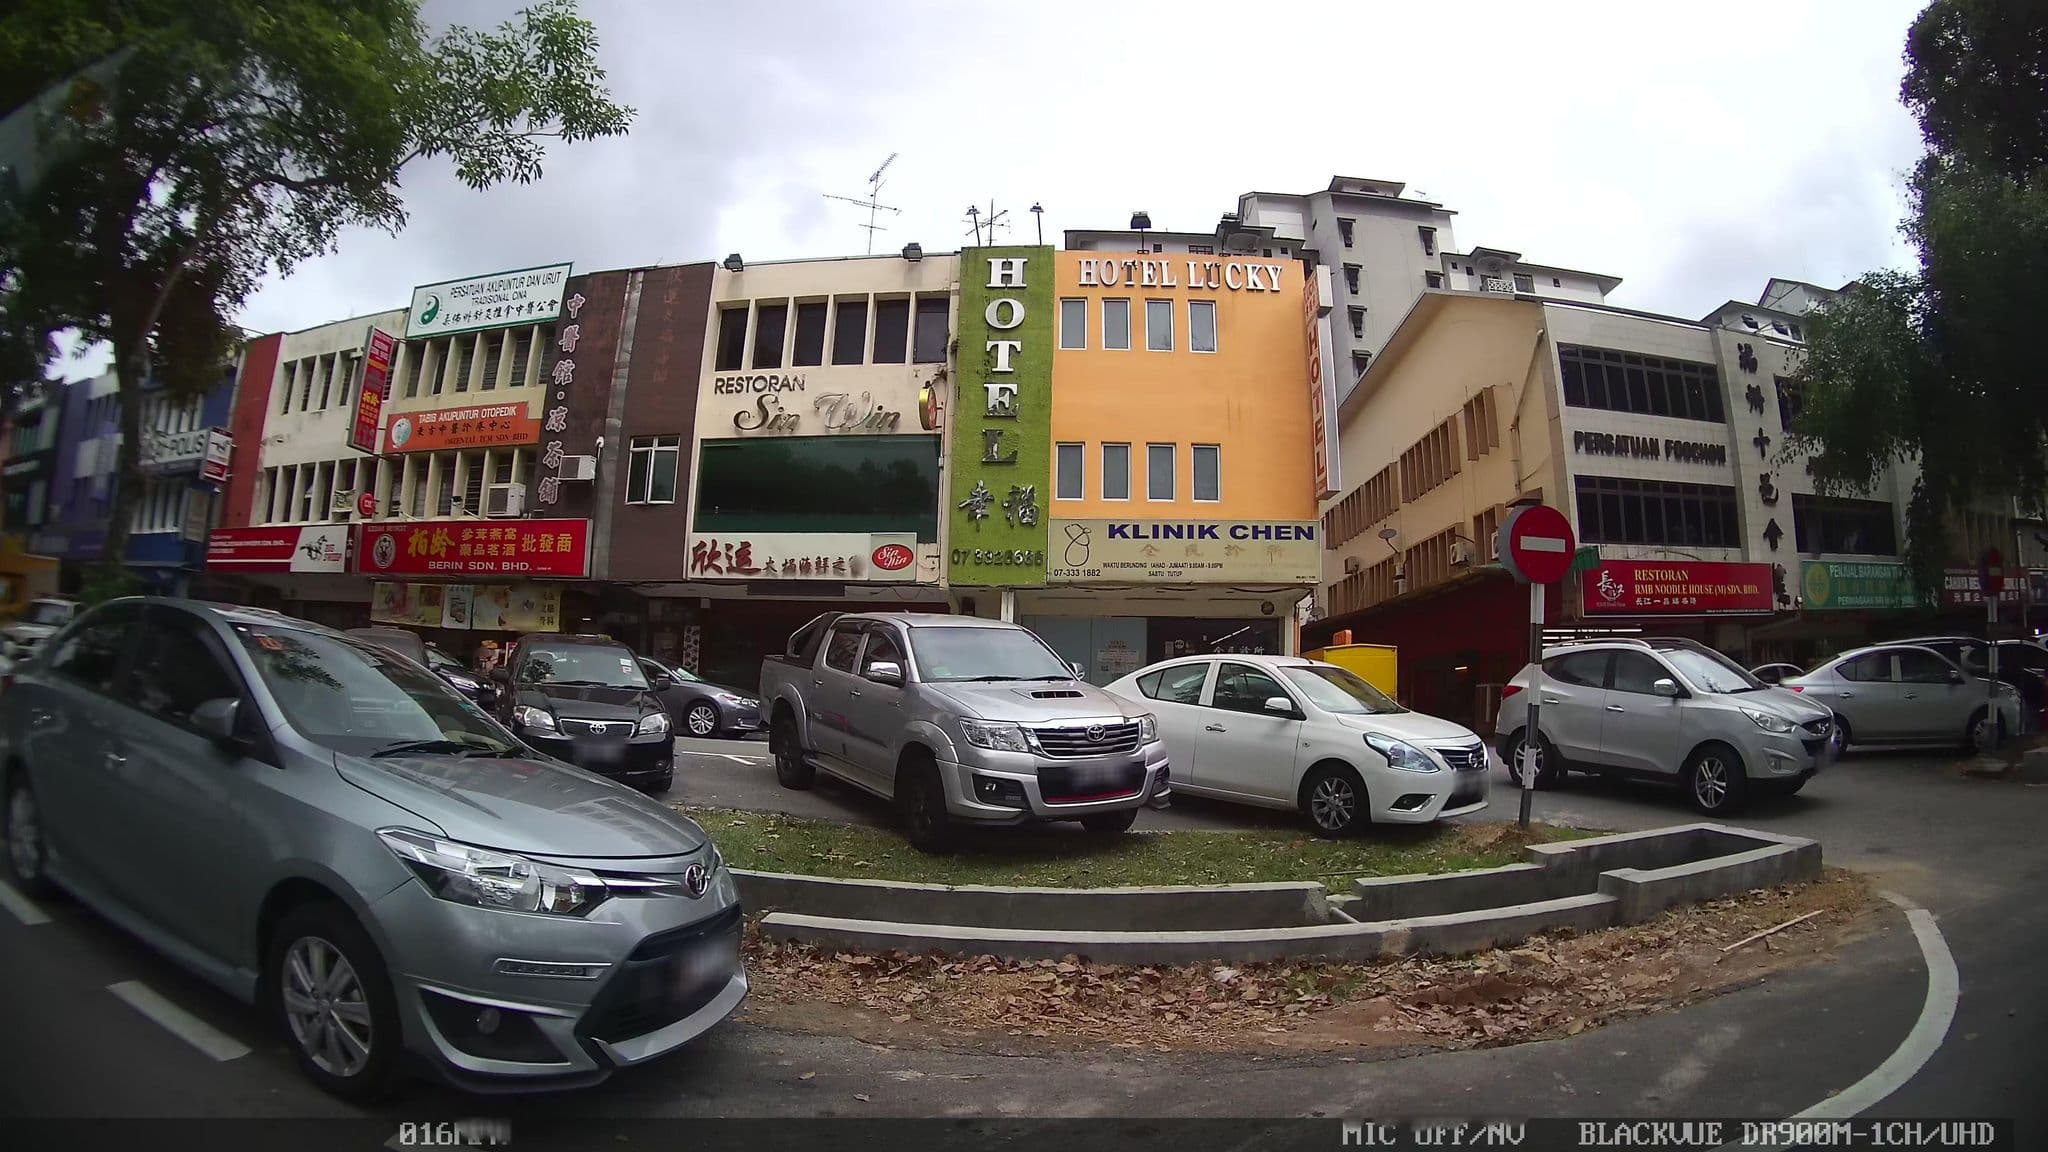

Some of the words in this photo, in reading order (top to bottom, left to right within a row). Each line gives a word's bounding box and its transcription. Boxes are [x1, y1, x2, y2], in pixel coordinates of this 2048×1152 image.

[487, 276, 525, 292] AKUPUNTUR
[526, 274, 541, 287] DAN
[542, 271, 562, 284] URUT
[1079, 259, 1177, 287] HOTEL
[1186, 260, 1283, 292] LUCKY
[512, 291, 527, 301] CINA
[981, 258, 1028, 464] HOTEL
[714, 374, 805, 395] RESTORAN
[1308, 325, 1327, 478] HOTEL
[438, 408, 479, 422] AKUPUNTUR
[481, 405, 517, 418] OTOPEDIK
[733, 393, 801, 432] Sin
[813, 390, 901, 431] Win
[512, 432, 529, 440] BHD
[1574, 430, 1661, 462] PERSATUAN
[1664, 439, 1727, 467] FOOCHOW
[1108, 523, 1221, 540] KLINIK
[1229, 524, 1315, 541] CHEN
[877, 546, 899, 560] Sin
[951, 548, 971, 566] 07
[428, 561, 463, 570] BERIN
[468, 561, 498, 571] SDN.
[502, 562, 533, 571] BHD.
[1054, 569, 1081, 578] 07-333
[1082, 569, 1101, 578] 1882
[1634, 569, 1689, 581] RESTORAN
[1634, 584, 1654, 595] RMB
[1654, 584, 1688, 595] NOODLE
[1689, 584, 1714, 595] HOUSE
[1714, 584, 1727, 596] (M)
